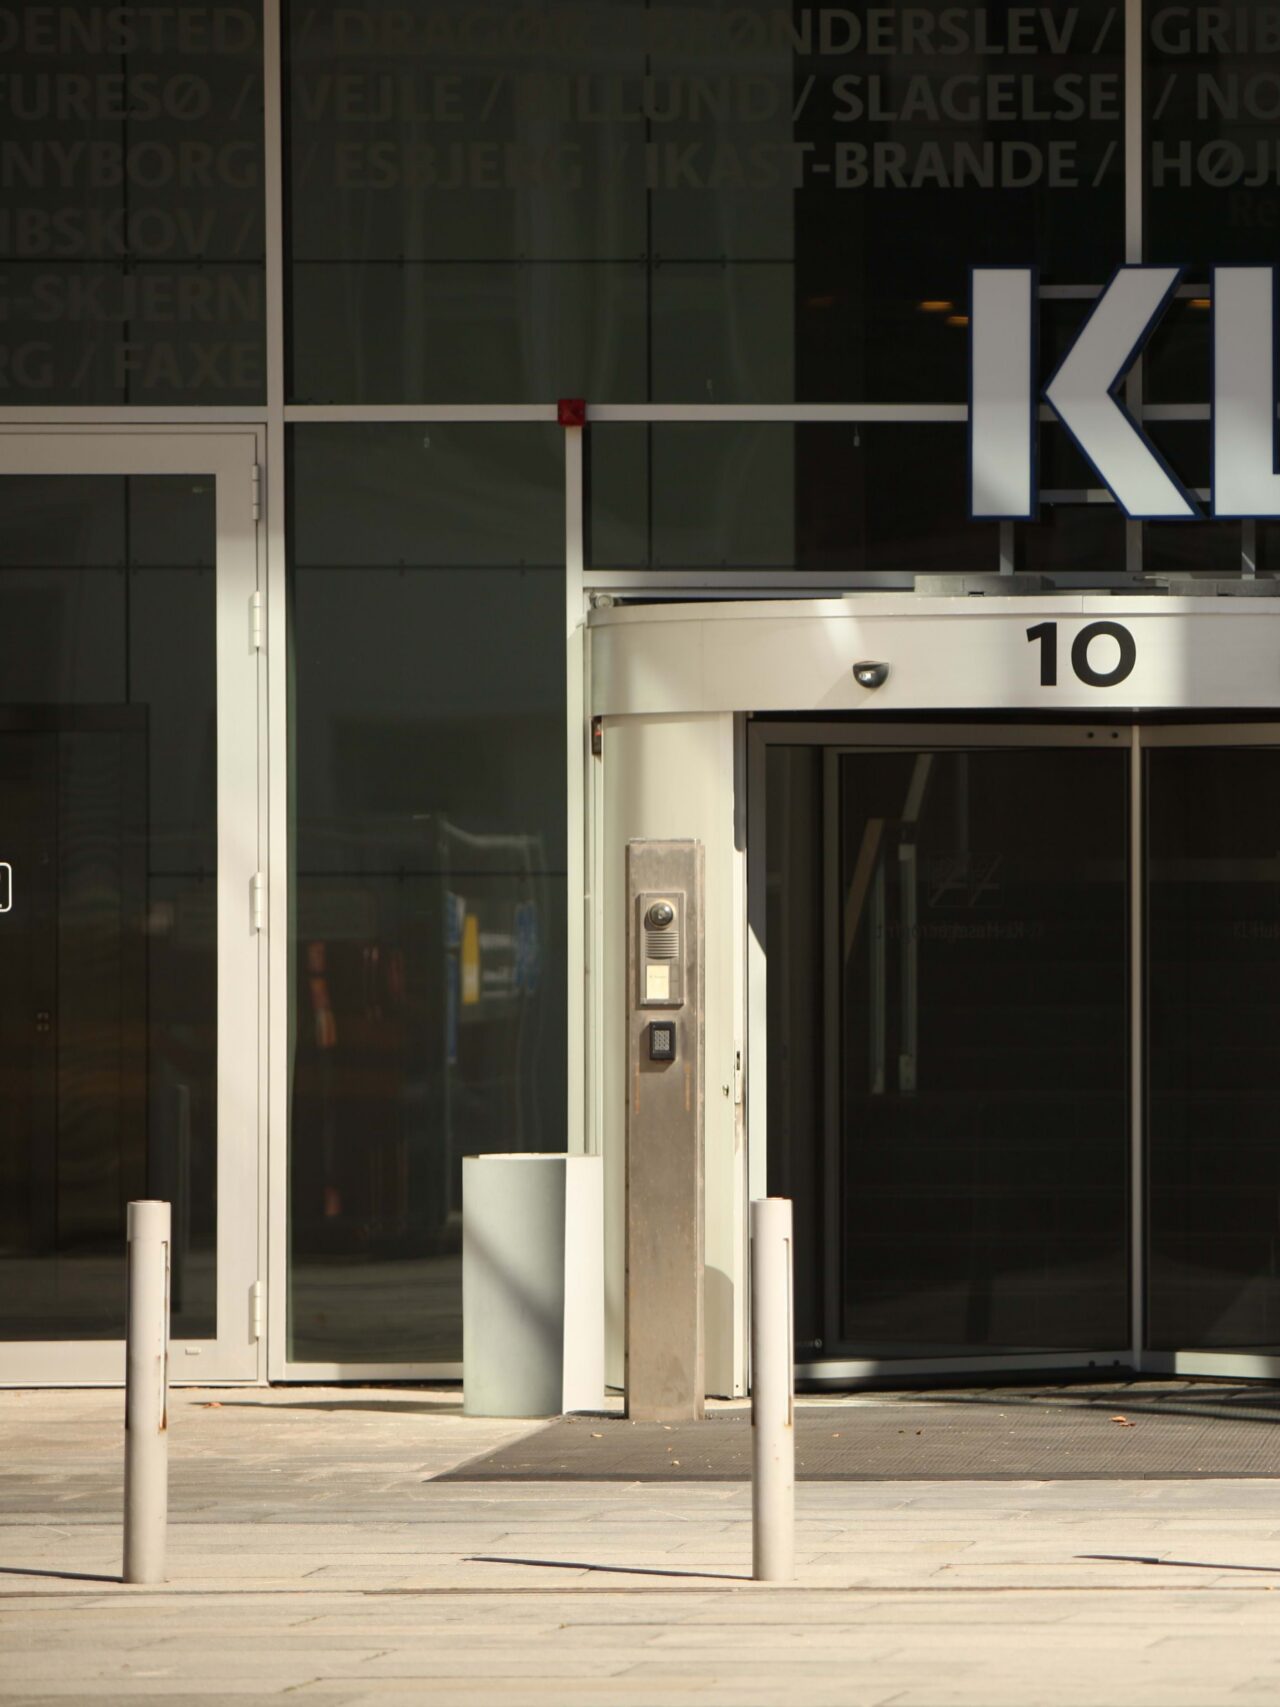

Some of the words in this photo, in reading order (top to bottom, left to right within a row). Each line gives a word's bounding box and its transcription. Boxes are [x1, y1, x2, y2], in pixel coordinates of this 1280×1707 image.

[0, 73, 210, 121] URESØ
[832, 74, 1119, 122] SLAGELSE
[2, 140, 257, 189] NYBORG
[646, 141, 1080, 190] IKAST-BRANDE
[0, 274, 260, 322] -SKJERN
[114, 341, 262, 389] FAXE
[1026, 621, 1137, 688] 10
